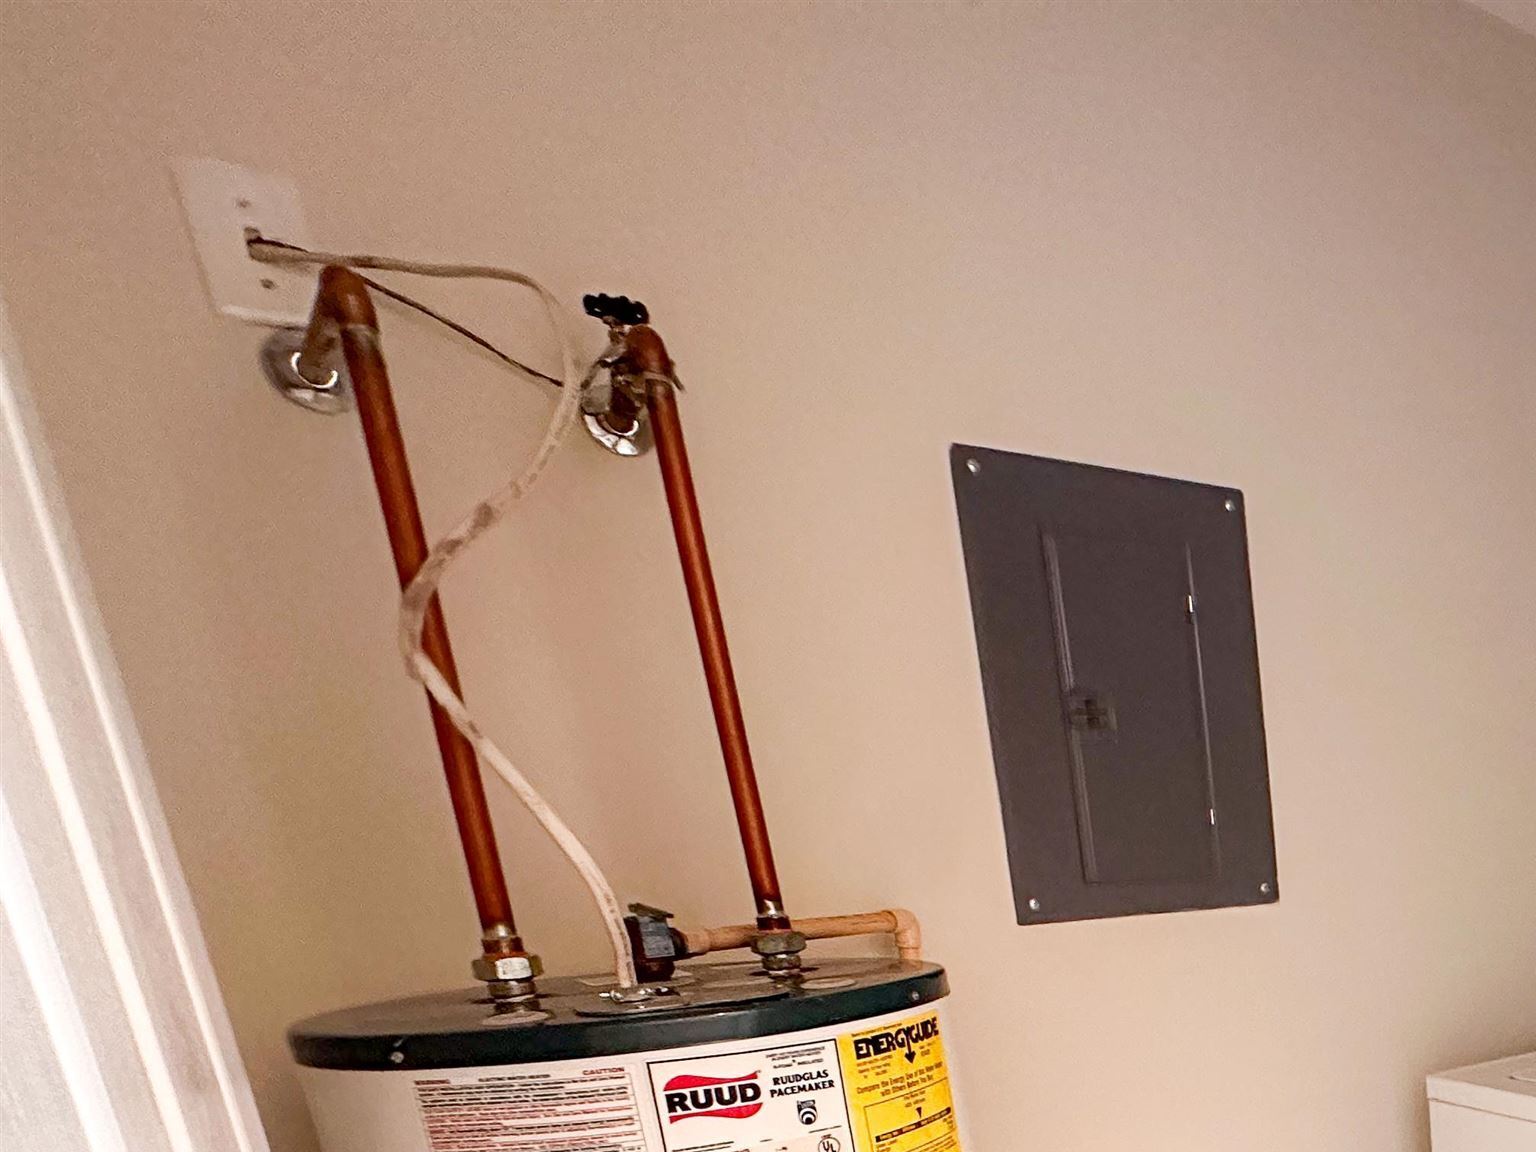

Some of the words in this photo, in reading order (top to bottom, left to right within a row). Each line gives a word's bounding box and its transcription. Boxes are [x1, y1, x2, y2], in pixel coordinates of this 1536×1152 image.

[853, 1016, 939, 1061] ENERGYGUIDE
[582, 1066, 625, 1077] CAUTION
[773, 1070, 829, 1086] RUUDGLAS
[665, 1082, 762, 1114] RUUD
[770, 1080, 835, 1098] PACEMAKER
